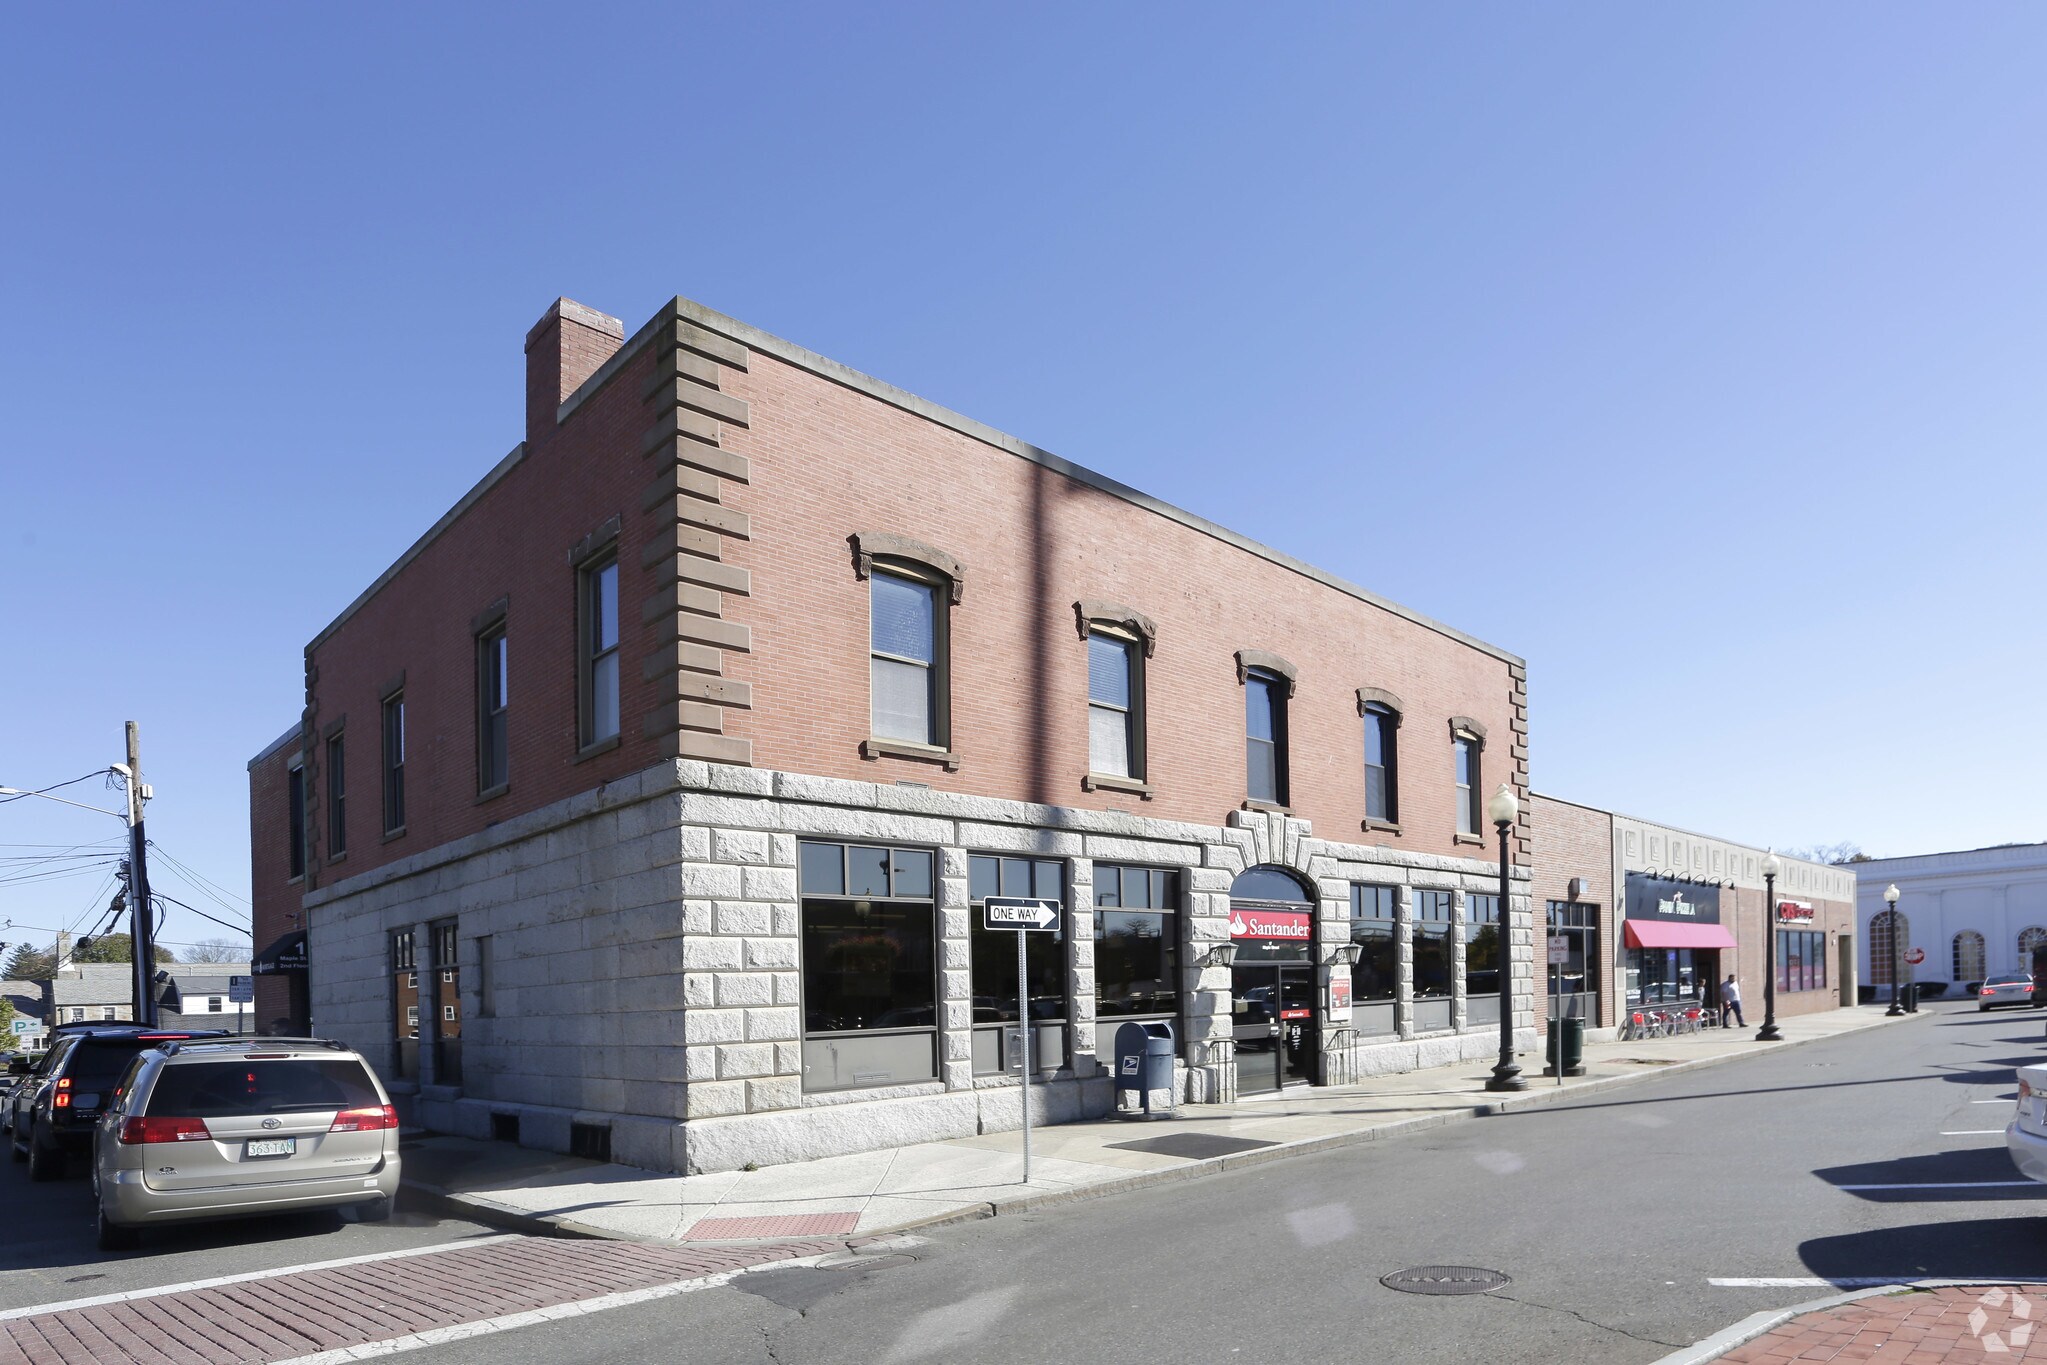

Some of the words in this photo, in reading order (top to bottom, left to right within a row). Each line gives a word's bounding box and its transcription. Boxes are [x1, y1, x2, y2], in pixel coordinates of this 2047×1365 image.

[993, 907, 1013, 920] ONE
[1018, 908, 1037, 921] WAY
[1249, 918, 1310, 937] Santander
[295, 941, 304, 955] 1
[15, 1021, 27, 1033] P
